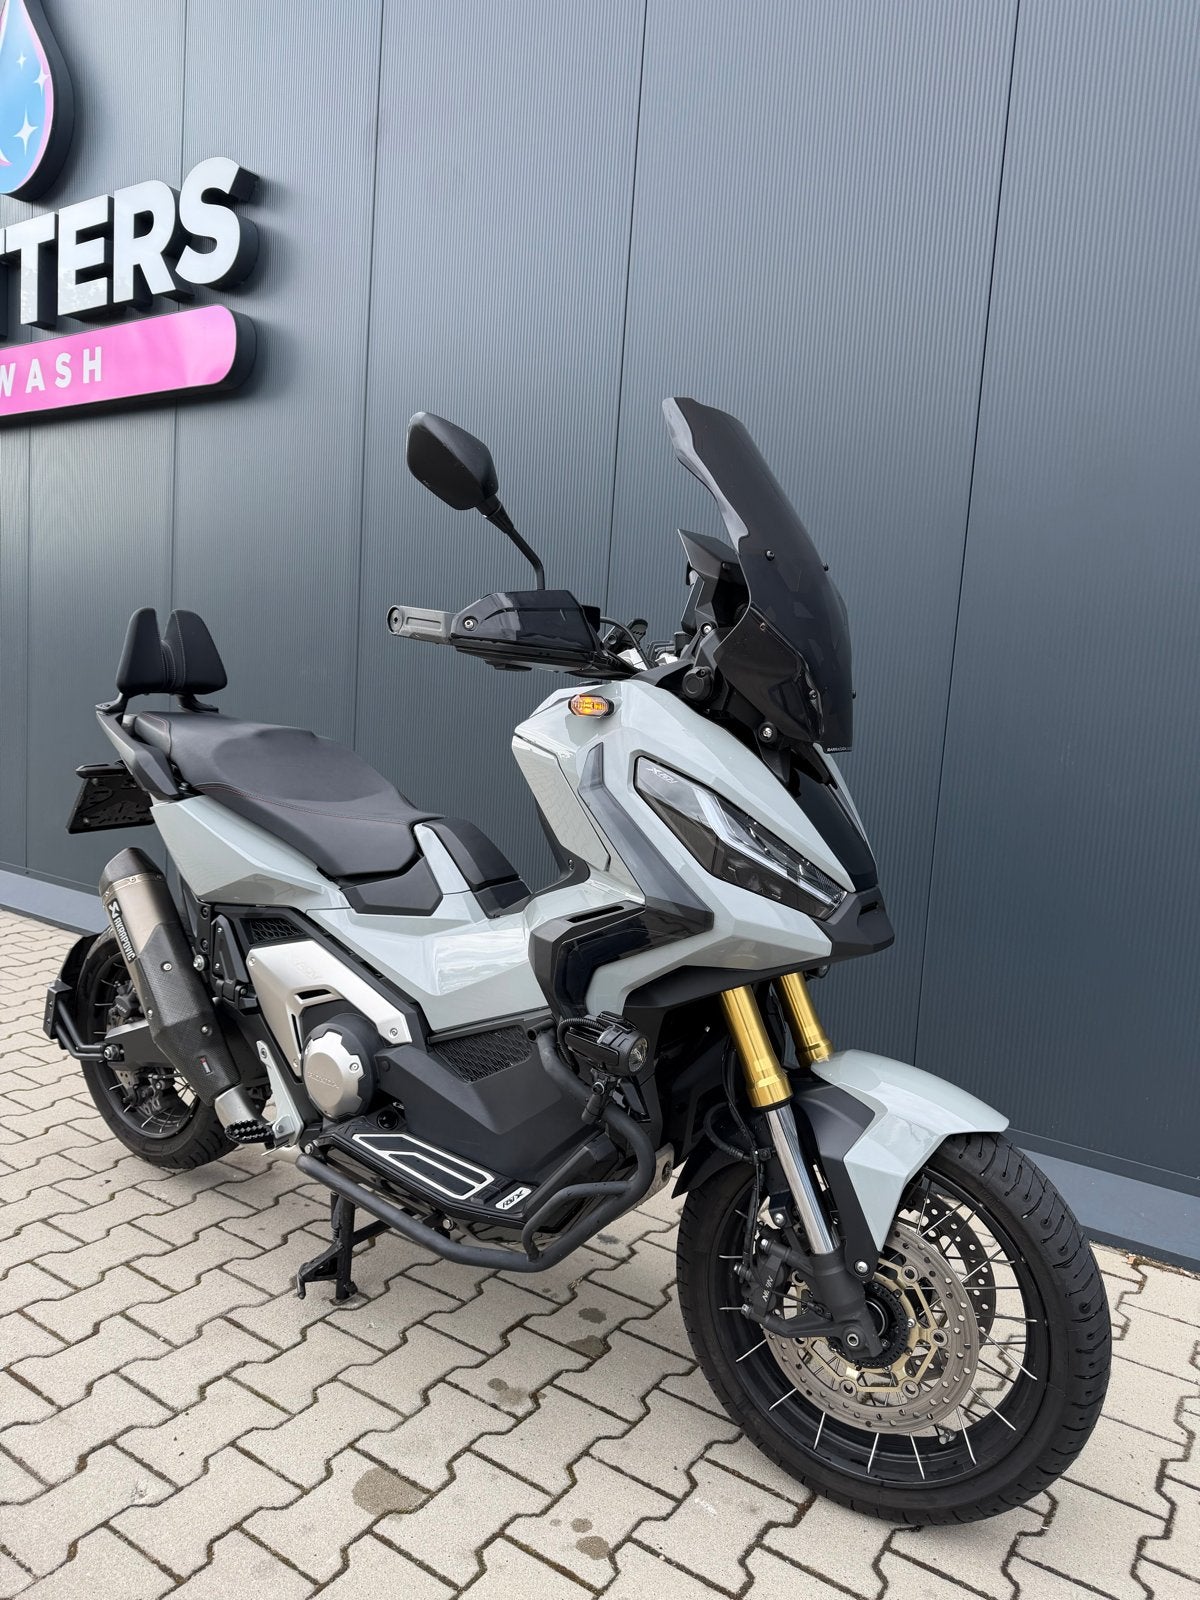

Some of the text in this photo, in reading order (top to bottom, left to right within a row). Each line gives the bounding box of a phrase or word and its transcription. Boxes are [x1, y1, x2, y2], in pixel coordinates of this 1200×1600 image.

[0, 157, 240, 325] TERS
[0, 346, 102, 397] WASH
[113, 916, 136, 961] AKRAPOVIC
